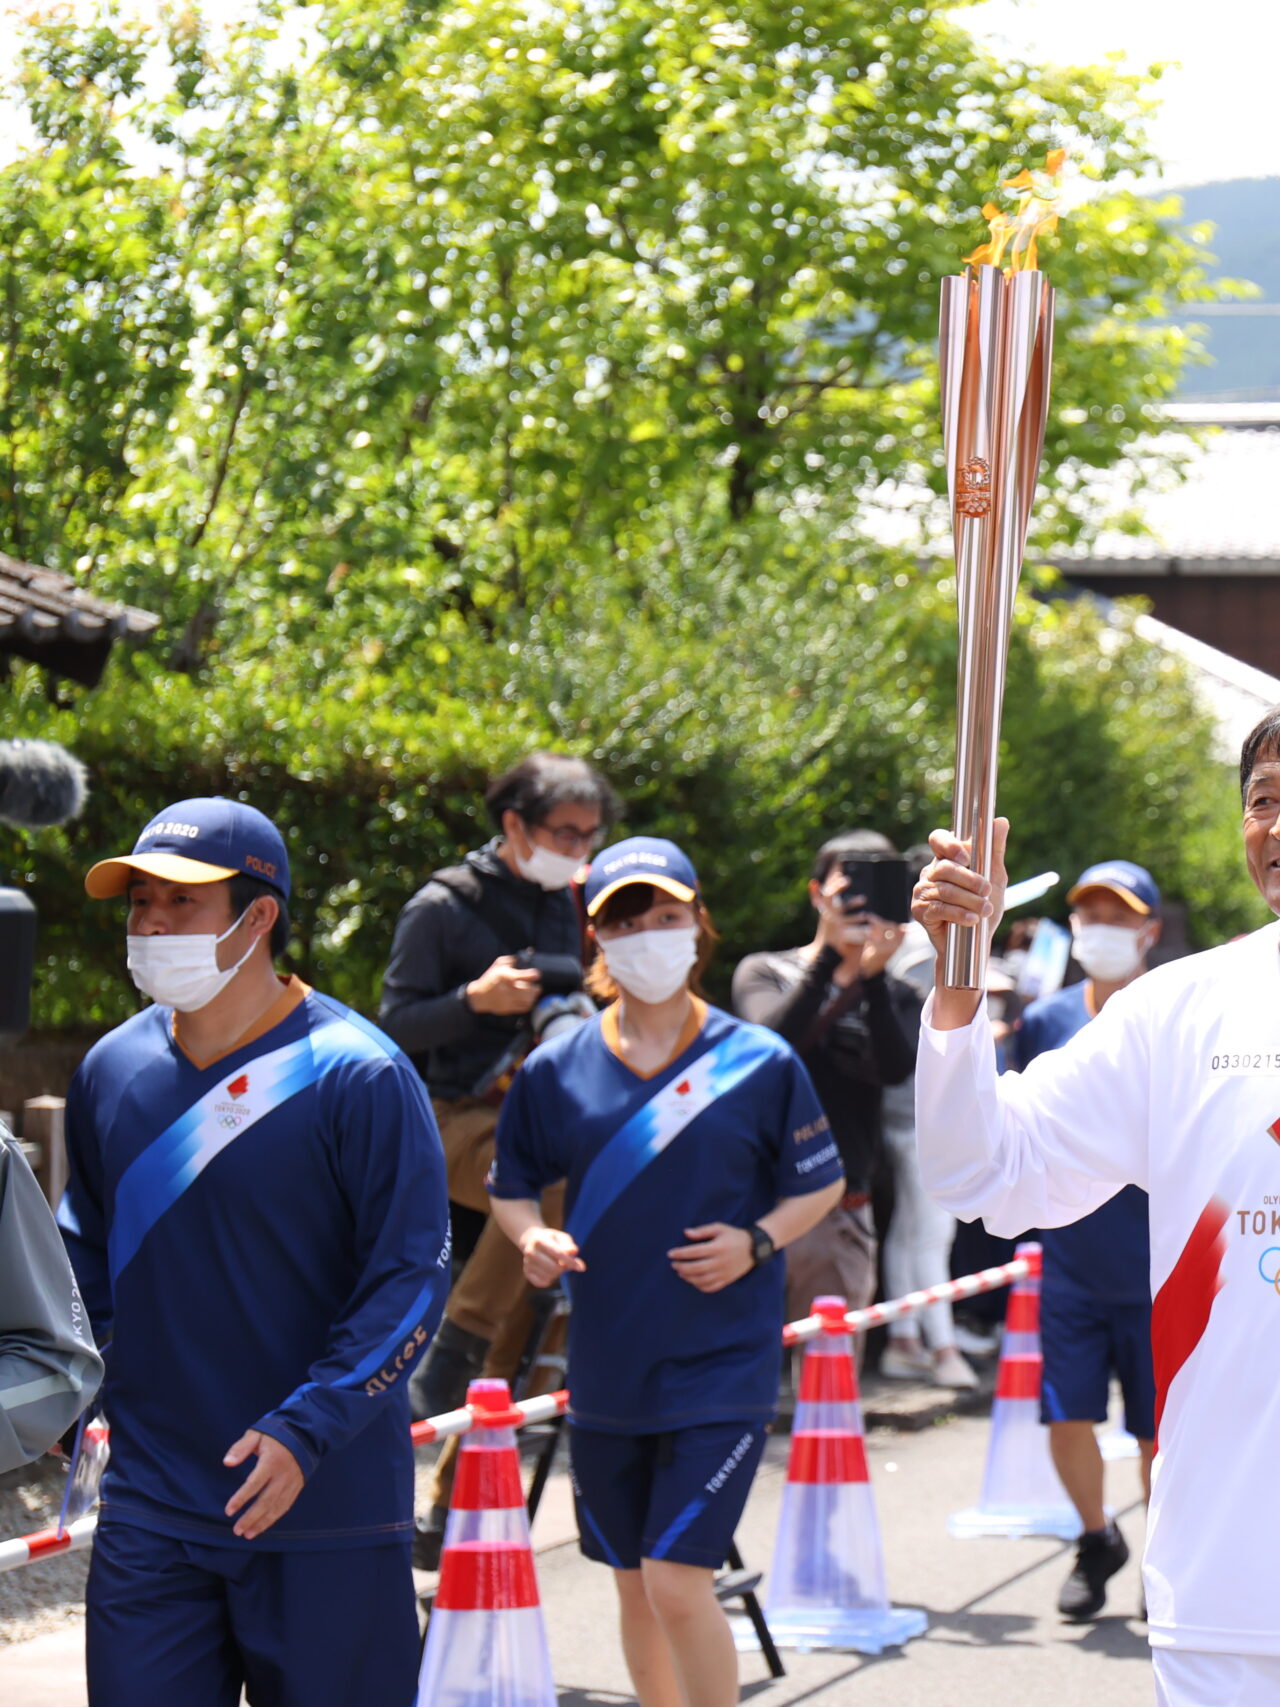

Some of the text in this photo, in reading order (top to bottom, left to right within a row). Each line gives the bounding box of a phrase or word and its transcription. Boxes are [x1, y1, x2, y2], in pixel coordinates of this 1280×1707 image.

[163, 822, 199, 839] 2020
[244, 855, 278, 880] POLICE
[365, 1325, 428, 1395] OLICE
[704, 1456, 738, 1494] TOKYO
